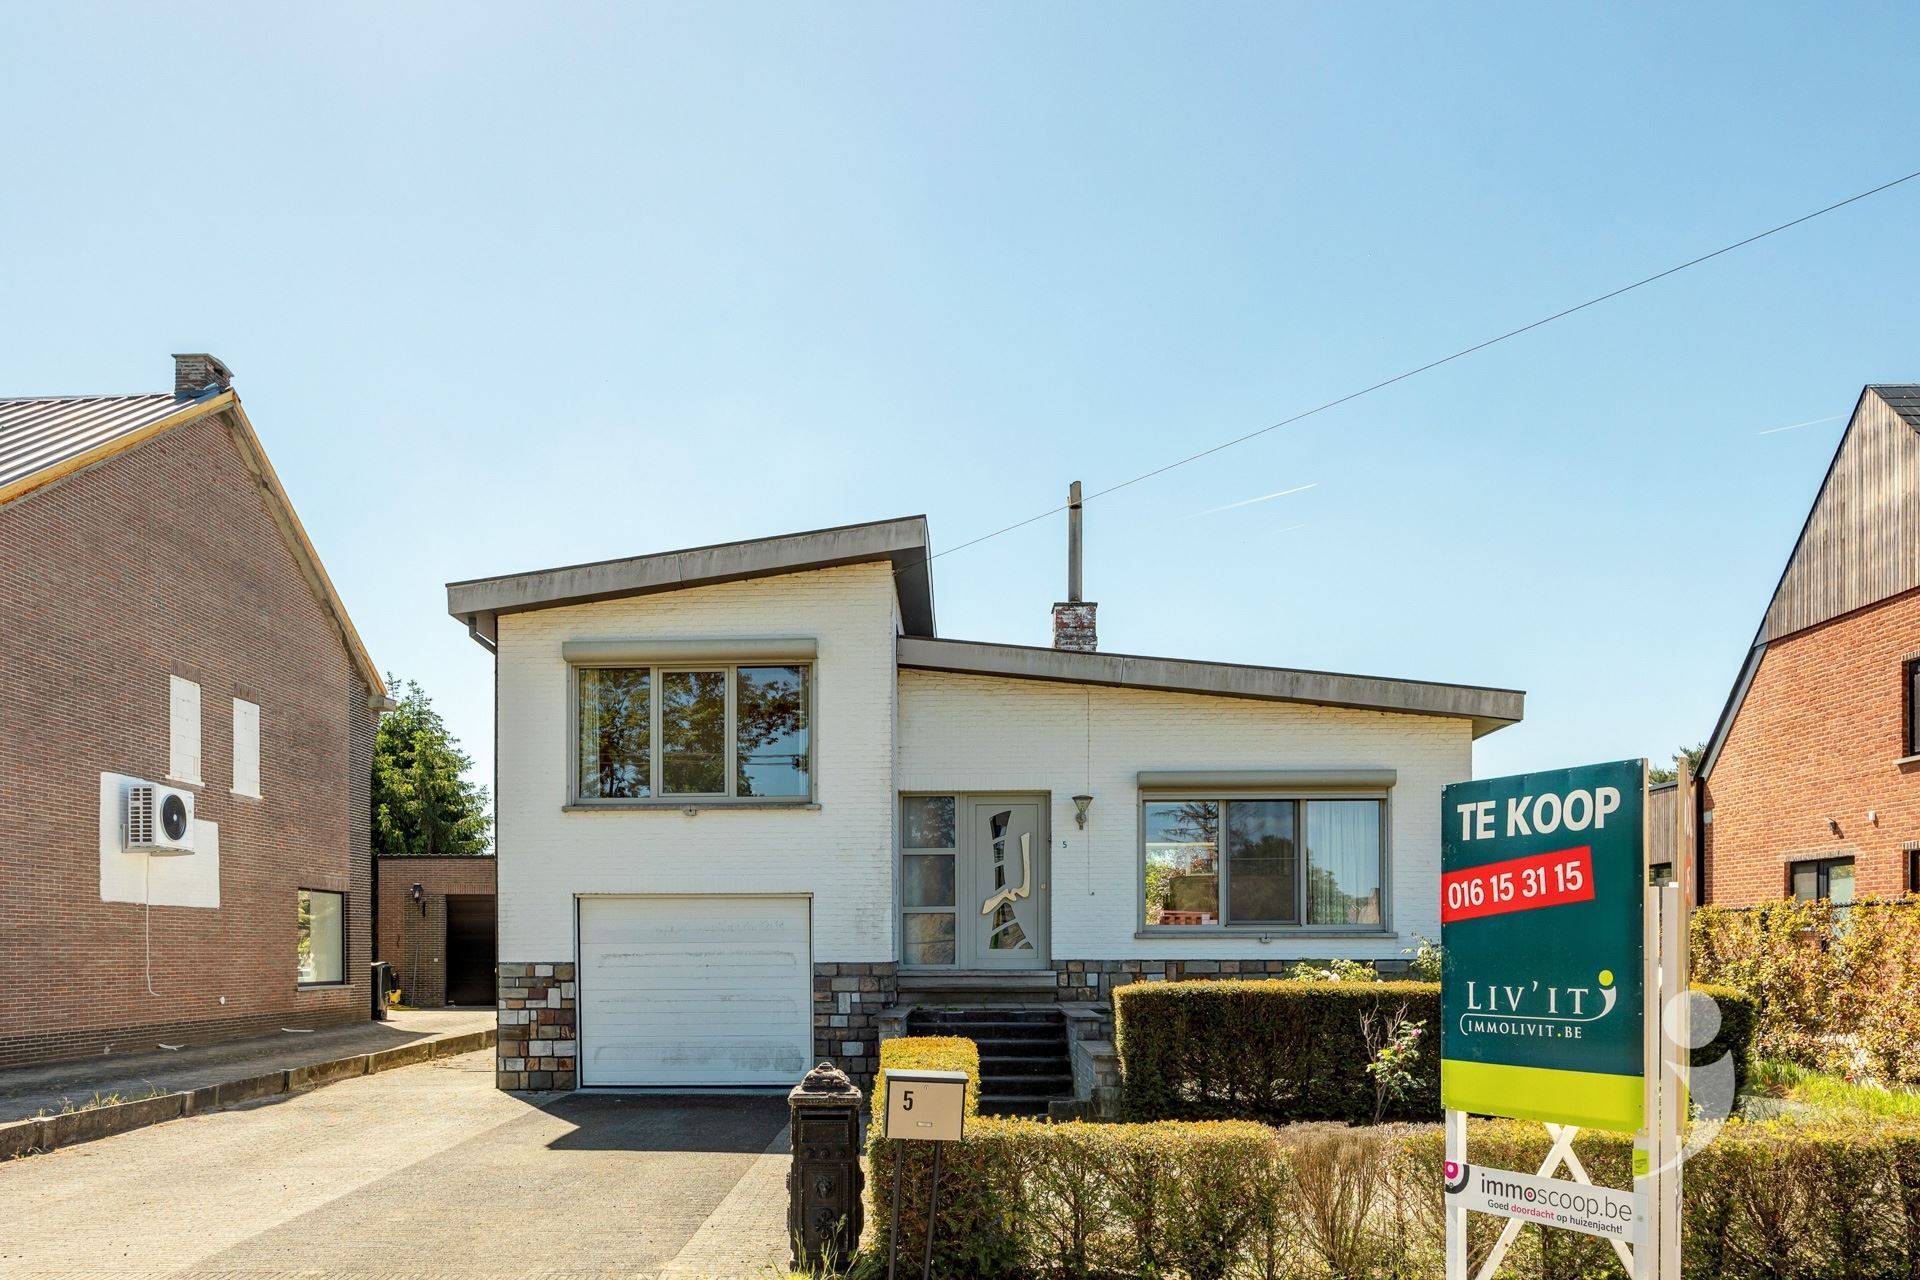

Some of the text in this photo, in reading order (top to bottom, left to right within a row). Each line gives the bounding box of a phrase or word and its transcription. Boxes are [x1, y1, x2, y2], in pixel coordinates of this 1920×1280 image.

[1457, 786, 1621, 841] TE KOOP
[1063, 841, 1068, 849] 5
[1447, 860, 1584, 911] 016 15 31 15
[1468, 1019, 1582, 1040] IMMOLIVIT.BE
[903, 1090, 914, 1111] 5
[1481, 1173, 1632, 1221] immoscoop.be
[1487, 1198, 1623, 1235] Goed doordacht op huizenjacht!
